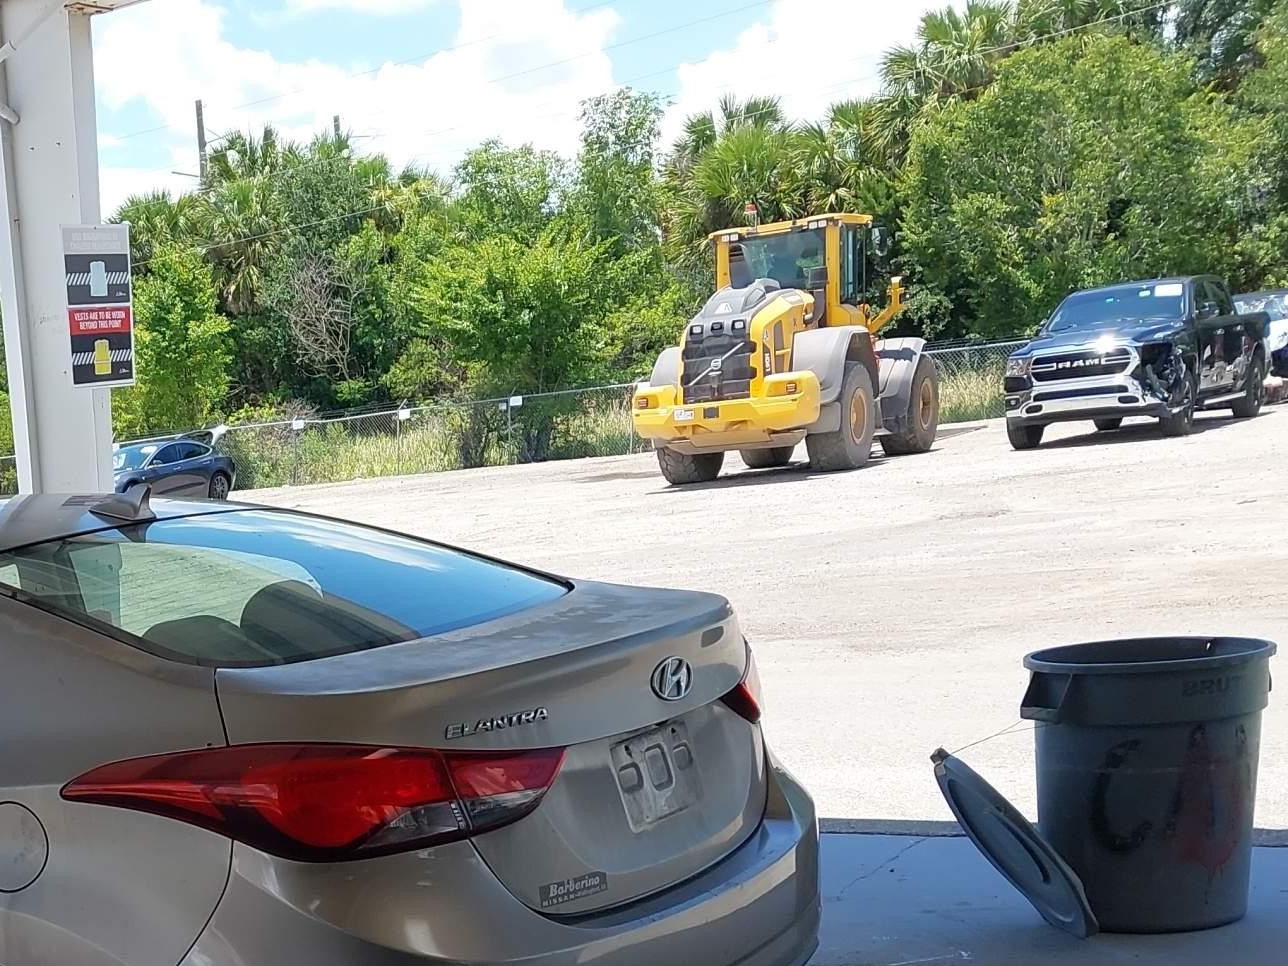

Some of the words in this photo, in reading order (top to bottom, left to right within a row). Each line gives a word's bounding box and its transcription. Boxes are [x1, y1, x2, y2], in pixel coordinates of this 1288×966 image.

[73, 312, 89, 321] VESTS
[89, 312, 98, 320] ARE
[99, 311, 105, 320] TO
[112, 310, 126, 319] WORN
[79, 321, 98, 330] BEYOND
[98, 320, 108, 328] THIS
[109, 319, 122, 328] POINT
[1058, 358, 1100, 369] RAM
[445, 707, 548, 739] ELANTRA
[549, 875, 600, 897] Barberino
